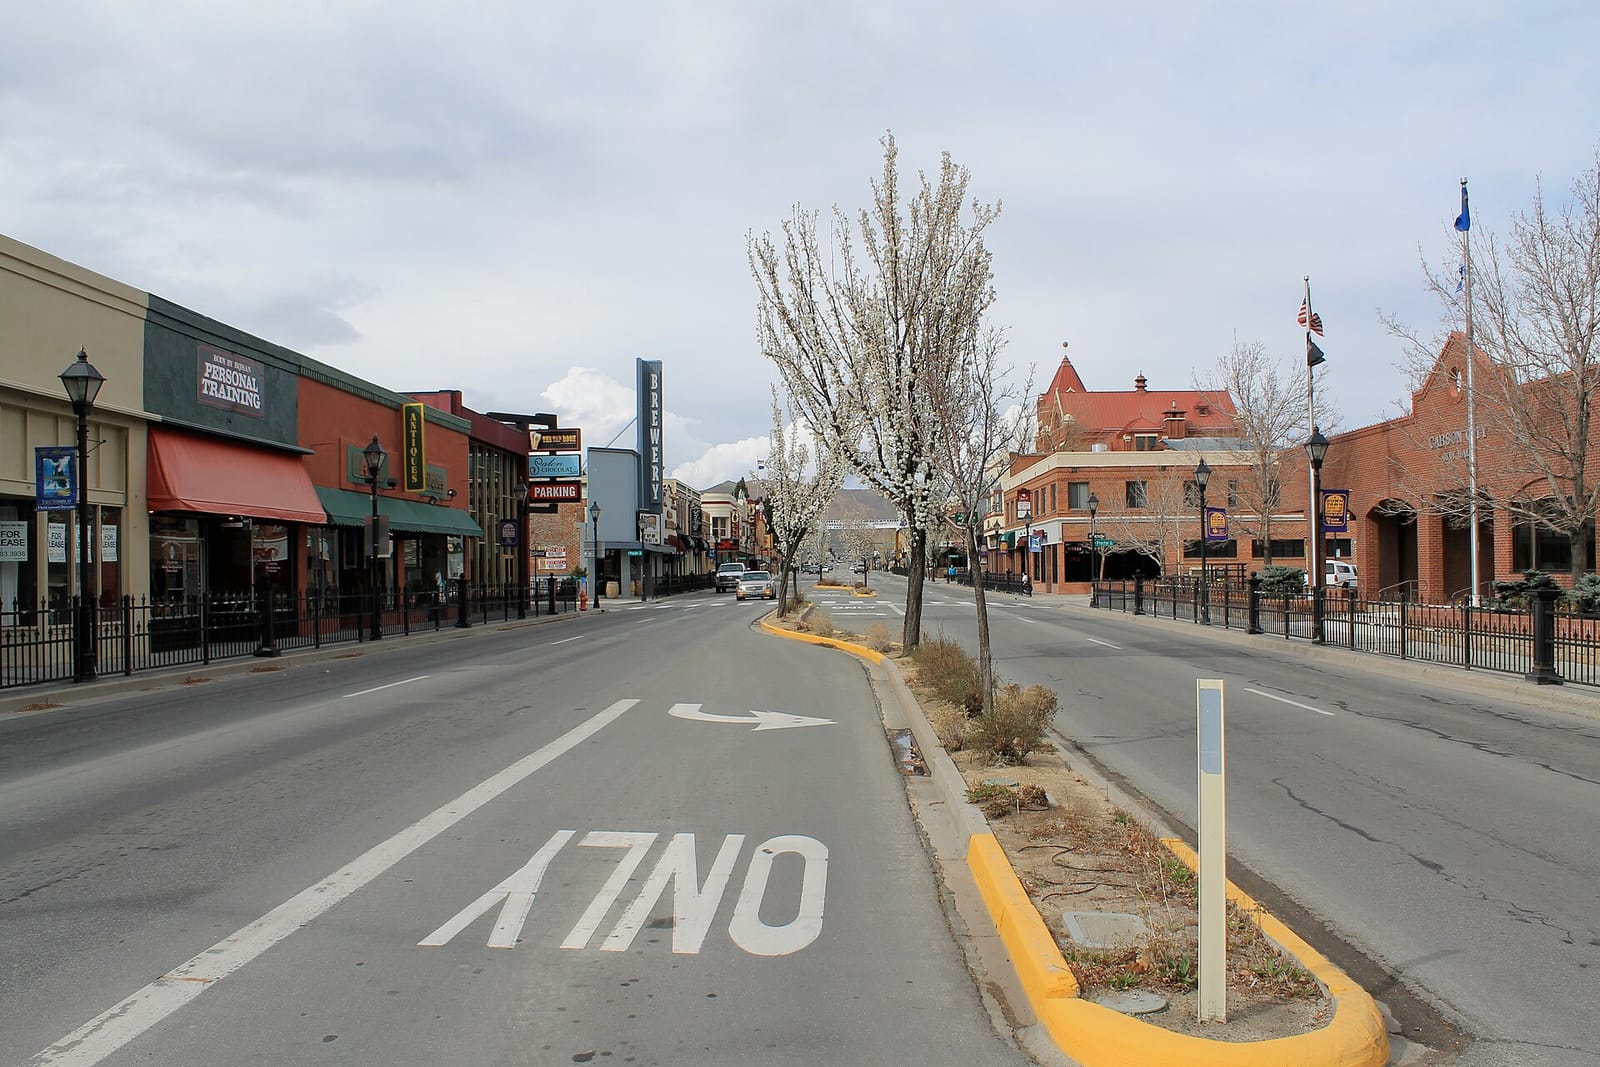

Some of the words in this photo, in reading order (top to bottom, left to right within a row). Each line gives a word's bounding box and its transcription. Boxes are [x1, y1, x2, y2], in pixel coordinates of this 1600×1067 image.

[204, 362, 259, 392] PERSONAL
[201, 377, 261, 409] TRAINING
[649, 373, 660, 500] BREWERY
[409, 412, 418, 483] ANTIQUES
[530, 457, 564, 475] Salon
[534, 486, 576, 498] PARKING
[0, 530, 21, 538] FOR
[0, 538, 25, 547] EASE
[51, 532, 62, 540] FOR
[48, 540, 65, 548] LEASE
[416, 829, 829, 956] ONLY
